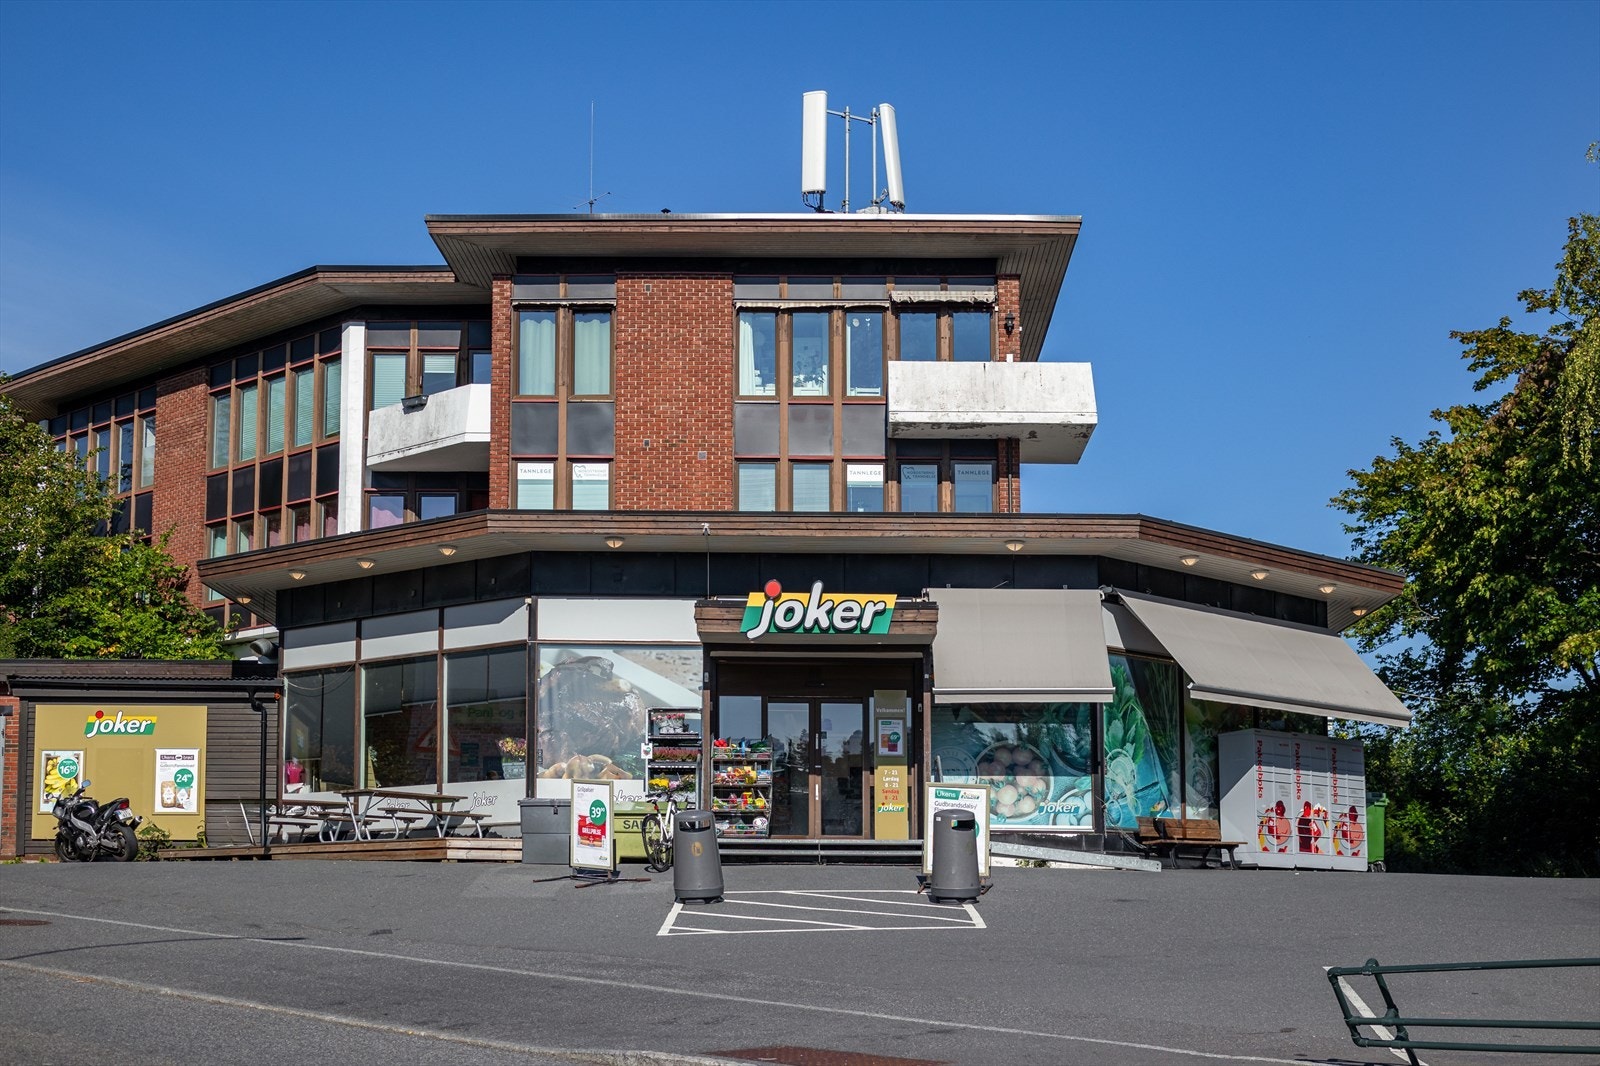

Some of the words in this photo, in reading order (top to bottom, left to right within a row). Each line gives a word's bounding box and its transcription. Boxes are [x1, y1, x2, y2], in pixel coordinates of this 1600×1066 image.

[746, 579, 887, 639] joker
[86, 710, 152, 738] joker
[470, 791, 498, 811] joker
[936, 790, 956, 798] Ukens
[879, 802, 902, 813] joker
[1040, 799, 1078, 815] joker
